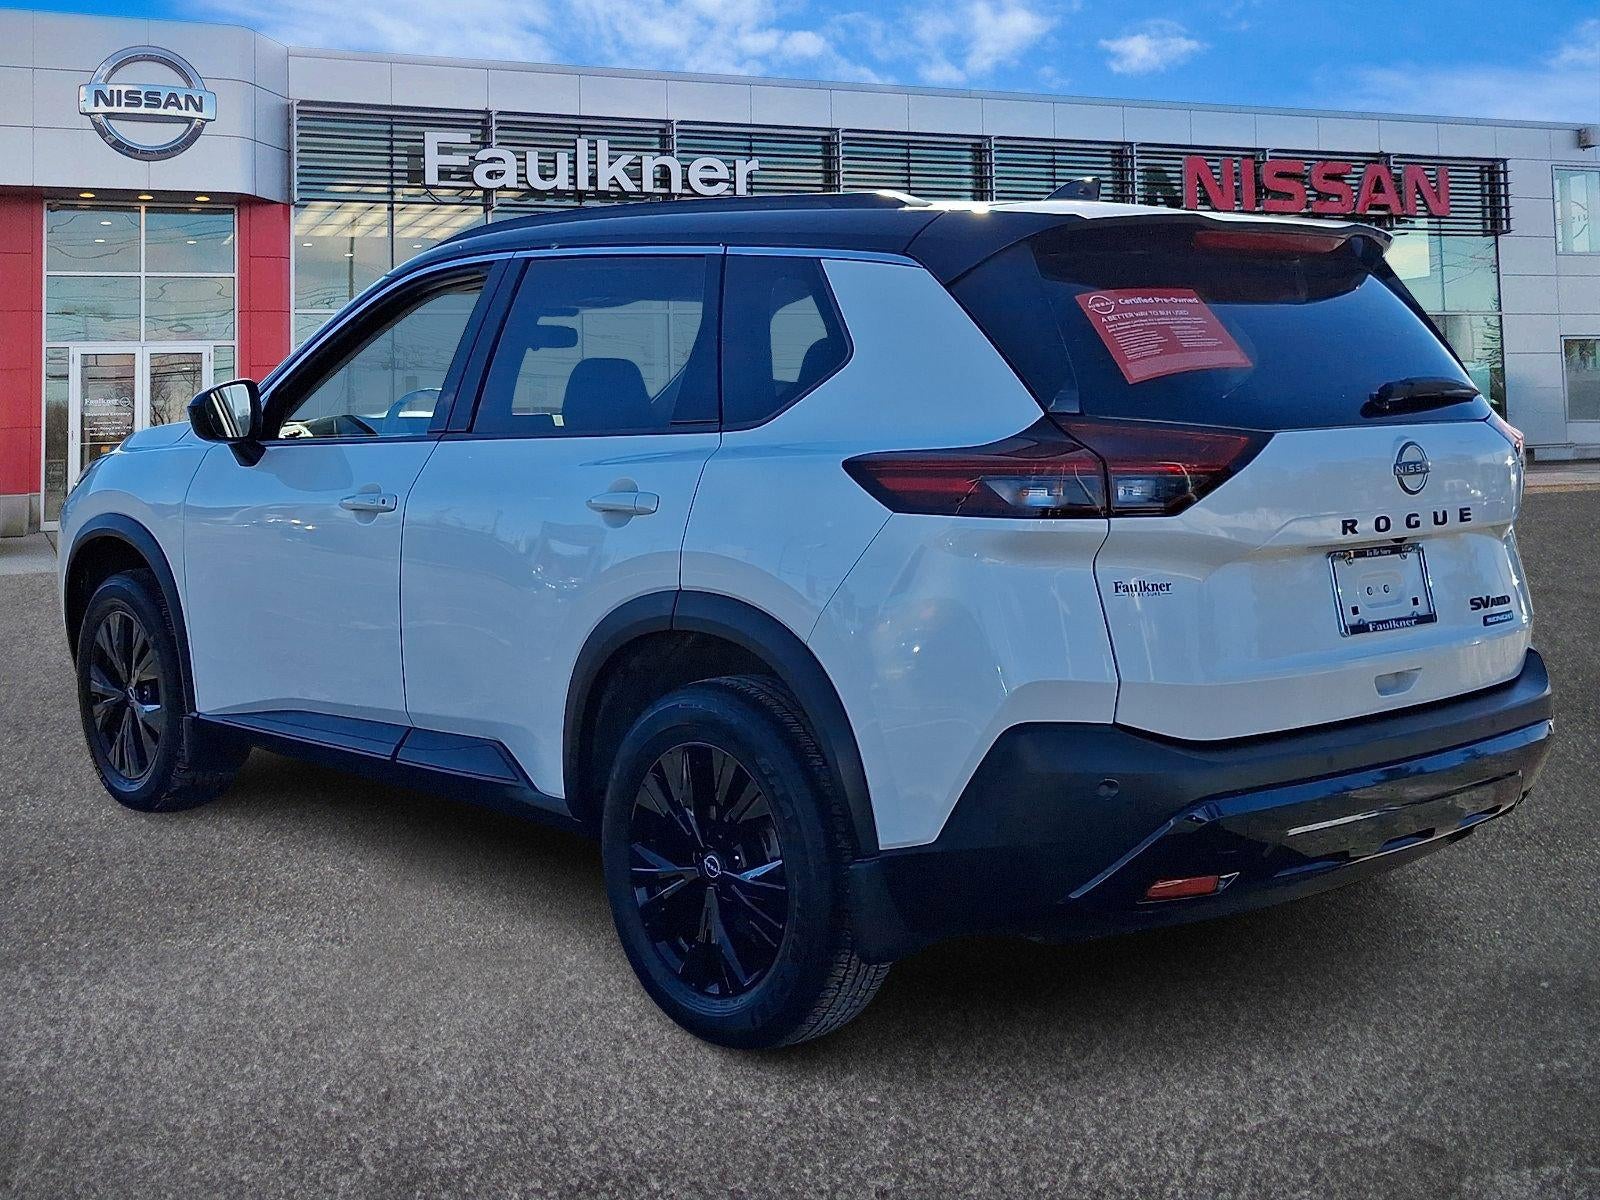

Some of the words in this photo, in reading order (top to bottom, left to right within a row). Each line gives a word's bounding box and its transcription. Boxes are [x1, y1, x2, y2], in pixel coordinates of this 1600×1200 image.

[94, 89, 204, 113] NISSAN
[423, 131, 760, 197] Faulkner
[1183, 155, 1451, 216] NISSAN
[1118, 296, 1154, 305] Certified
[1155, 296, 1199, 305] Pre-Owned
[1107, 312, 1133, 322] BETTER
[1395, 463, 1429, 474] NISS
[1341, 506, 1473, 536] ROGUE
[1113, 579, 1172, 593] Faulkner
[1368, 619, 1418, 632] Faulkner
